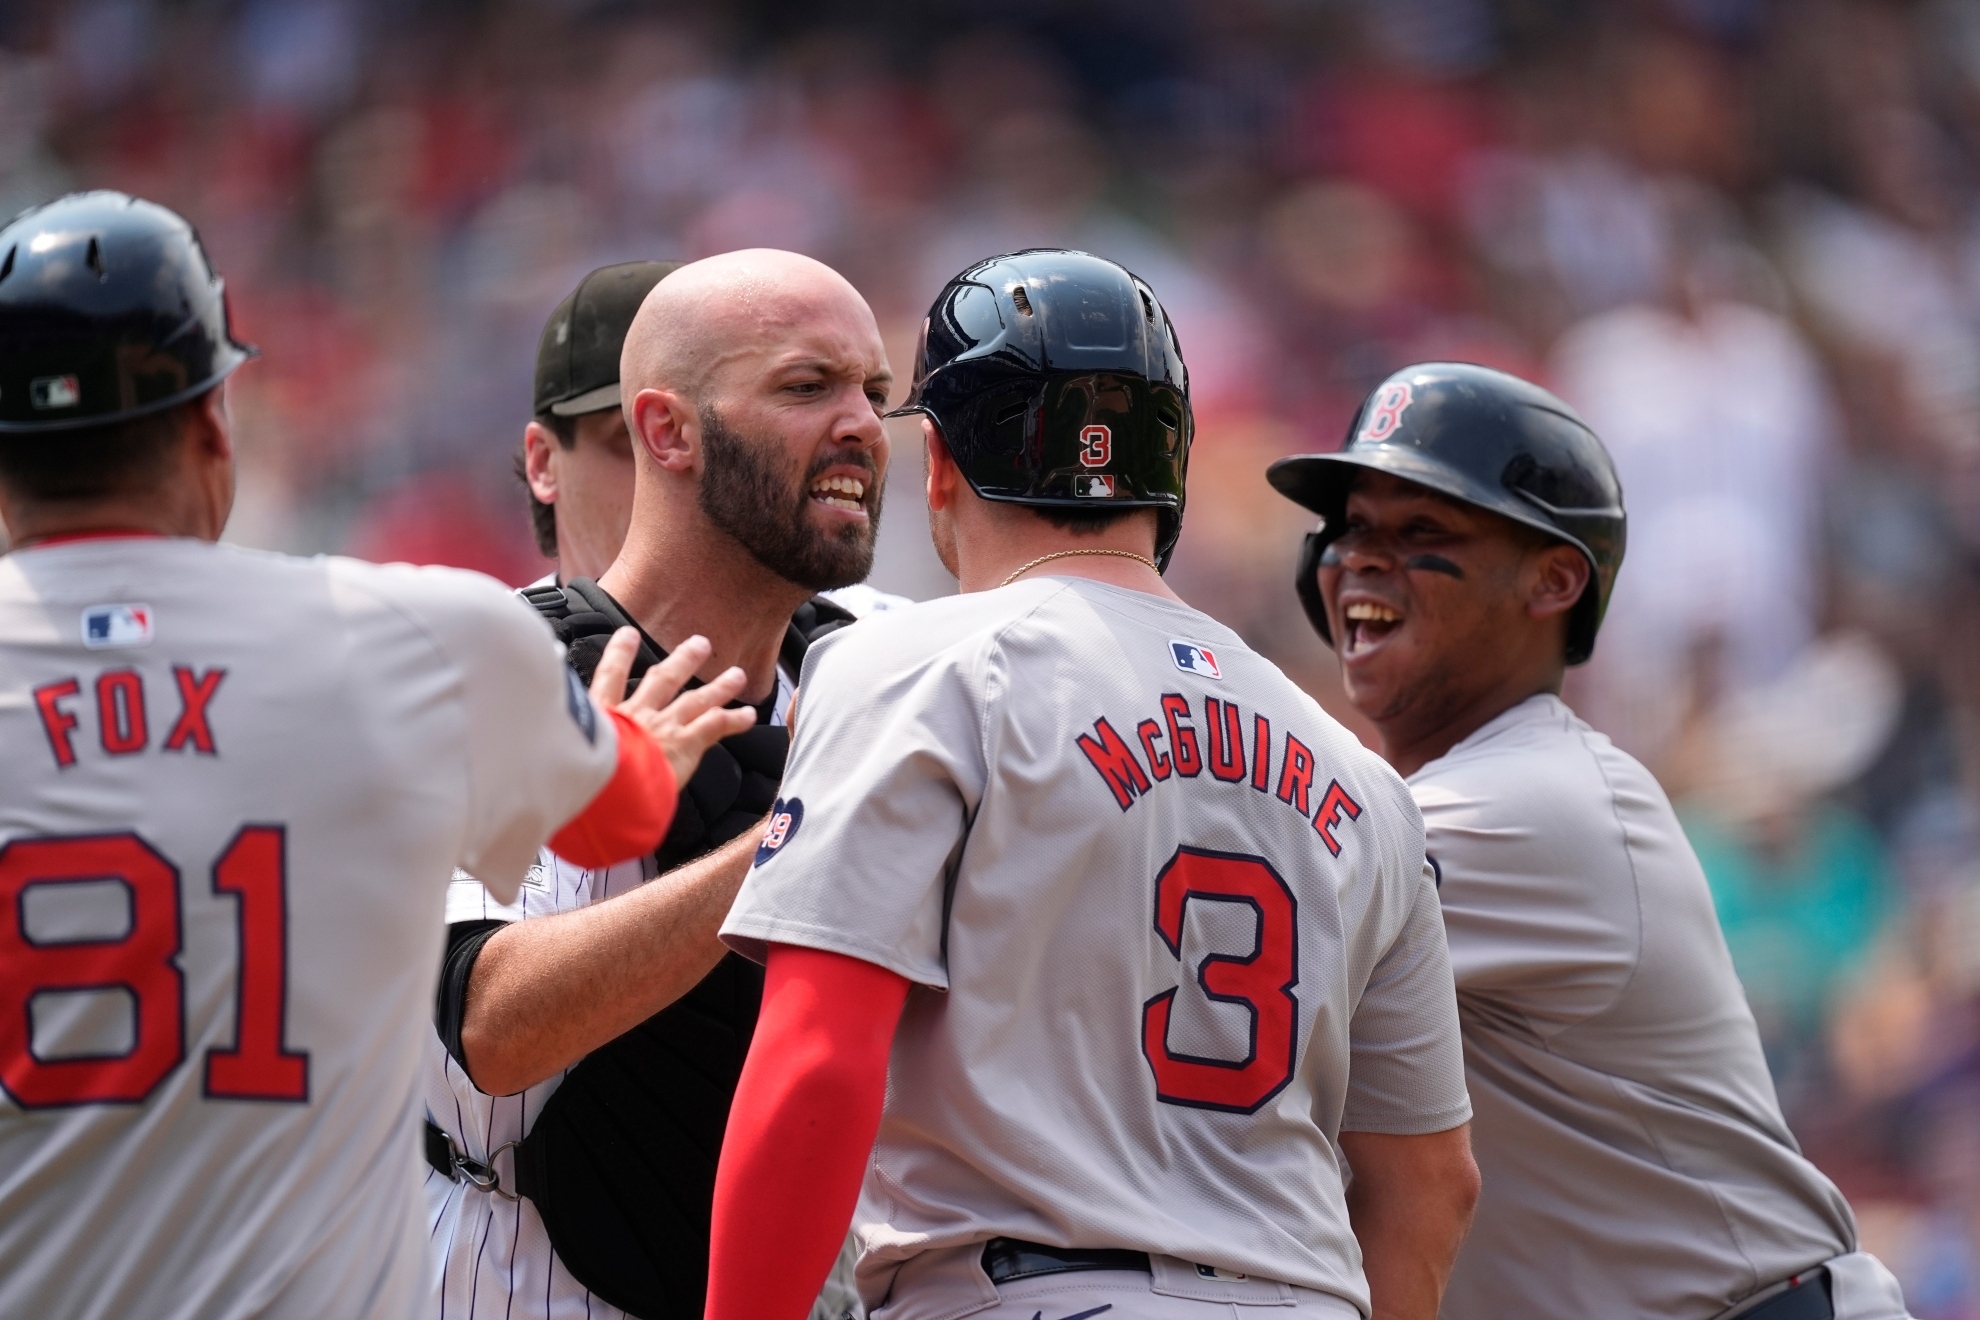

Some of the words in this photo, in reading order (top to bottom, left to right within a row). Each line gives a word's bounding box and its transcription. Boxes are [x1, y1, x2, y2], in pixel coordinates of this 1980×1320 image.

[1080, 425, 1111, 467] 3
[1358, 382, 1414, 443] B
[33, 664, 228, 770] FOX
[1075, 693, 1363, 858] McGUIRE
[0, 822, 310, 1110] 81
[1141, 844, 1299, 1115] 3
